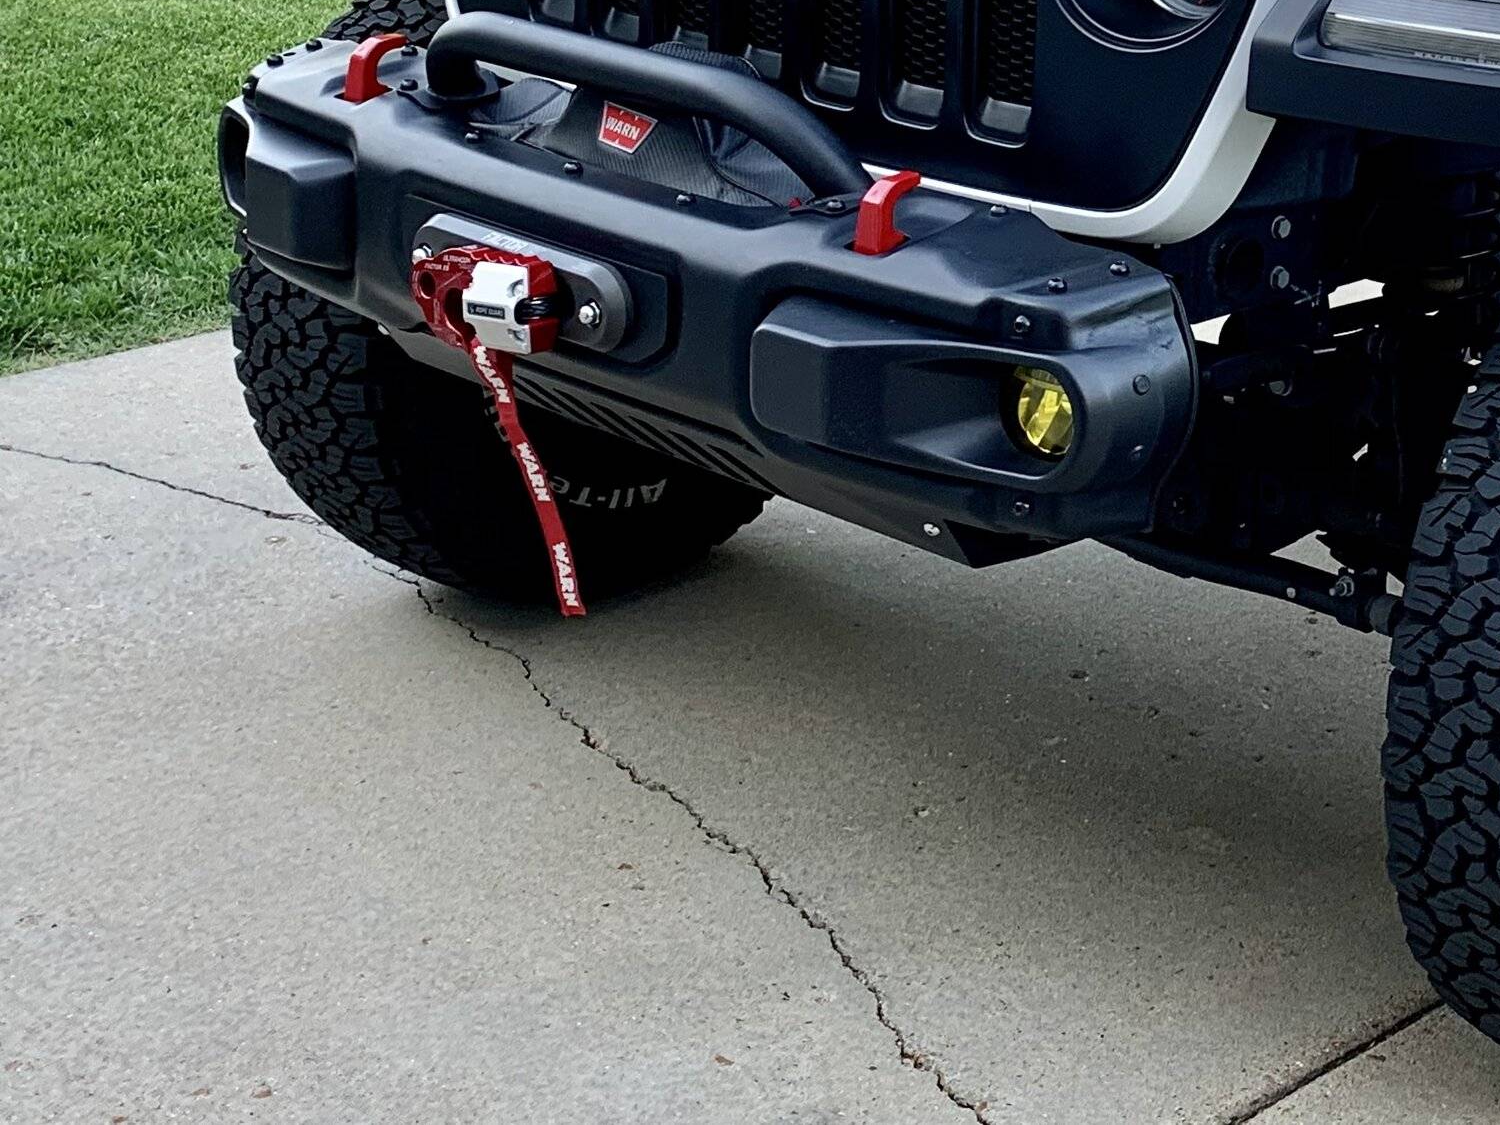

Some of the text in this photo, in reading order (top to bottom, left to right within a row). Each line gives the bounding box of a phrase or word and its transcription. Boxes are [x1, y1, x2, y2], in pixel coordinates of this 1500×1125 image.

[605, 115, 641, 141] WARN
[473, 345, 511, 403] WARN
[516, 442, 550, 502] WARN
[549, 475, 668, 509] All-Te
[552, 542, 580, 607] WARN
